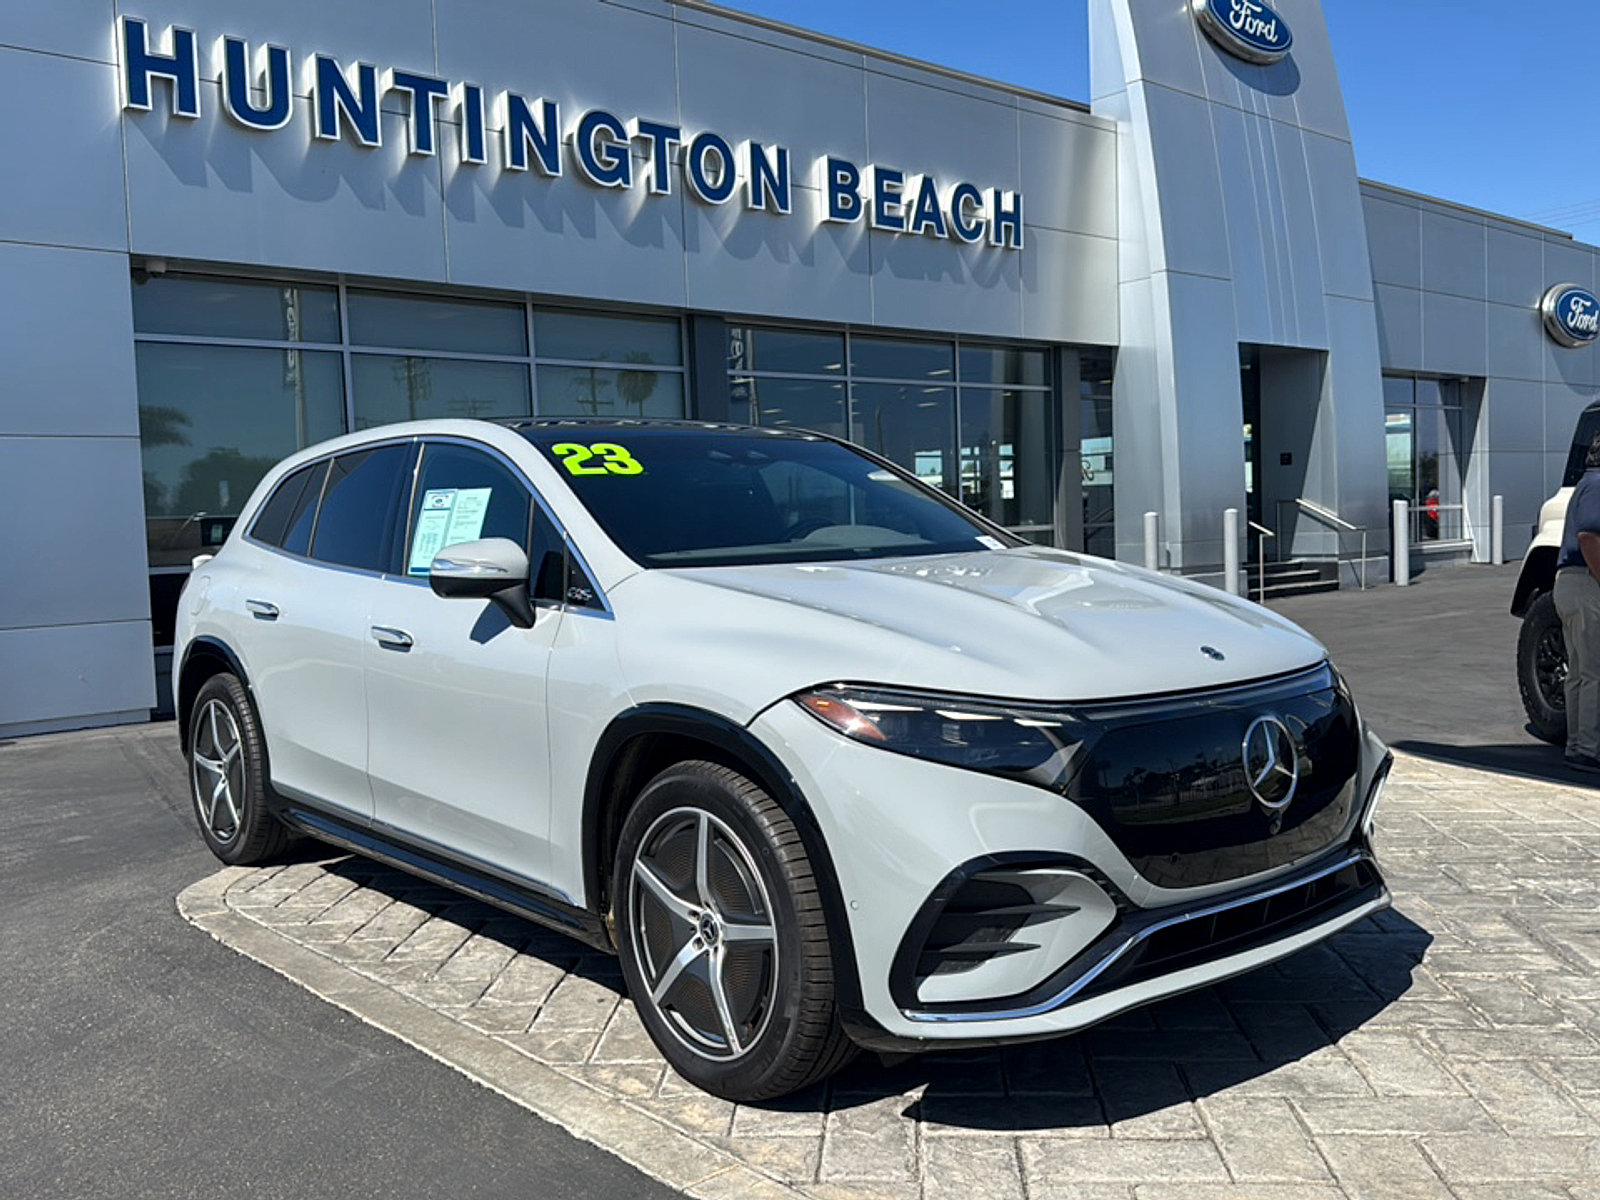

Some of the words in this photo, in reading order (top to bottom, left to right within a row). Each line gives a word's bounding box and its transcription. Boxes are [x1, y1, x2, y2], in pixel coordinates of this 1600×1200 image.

[1229, 0, 1279, 43] Ford
[118, 15, 792, 215] HUNTINGTON
[819, 153, 1025, 250] BEACH
[1566, 296, 1600, 333] Ford
[551, 442, 644, 476] 23
